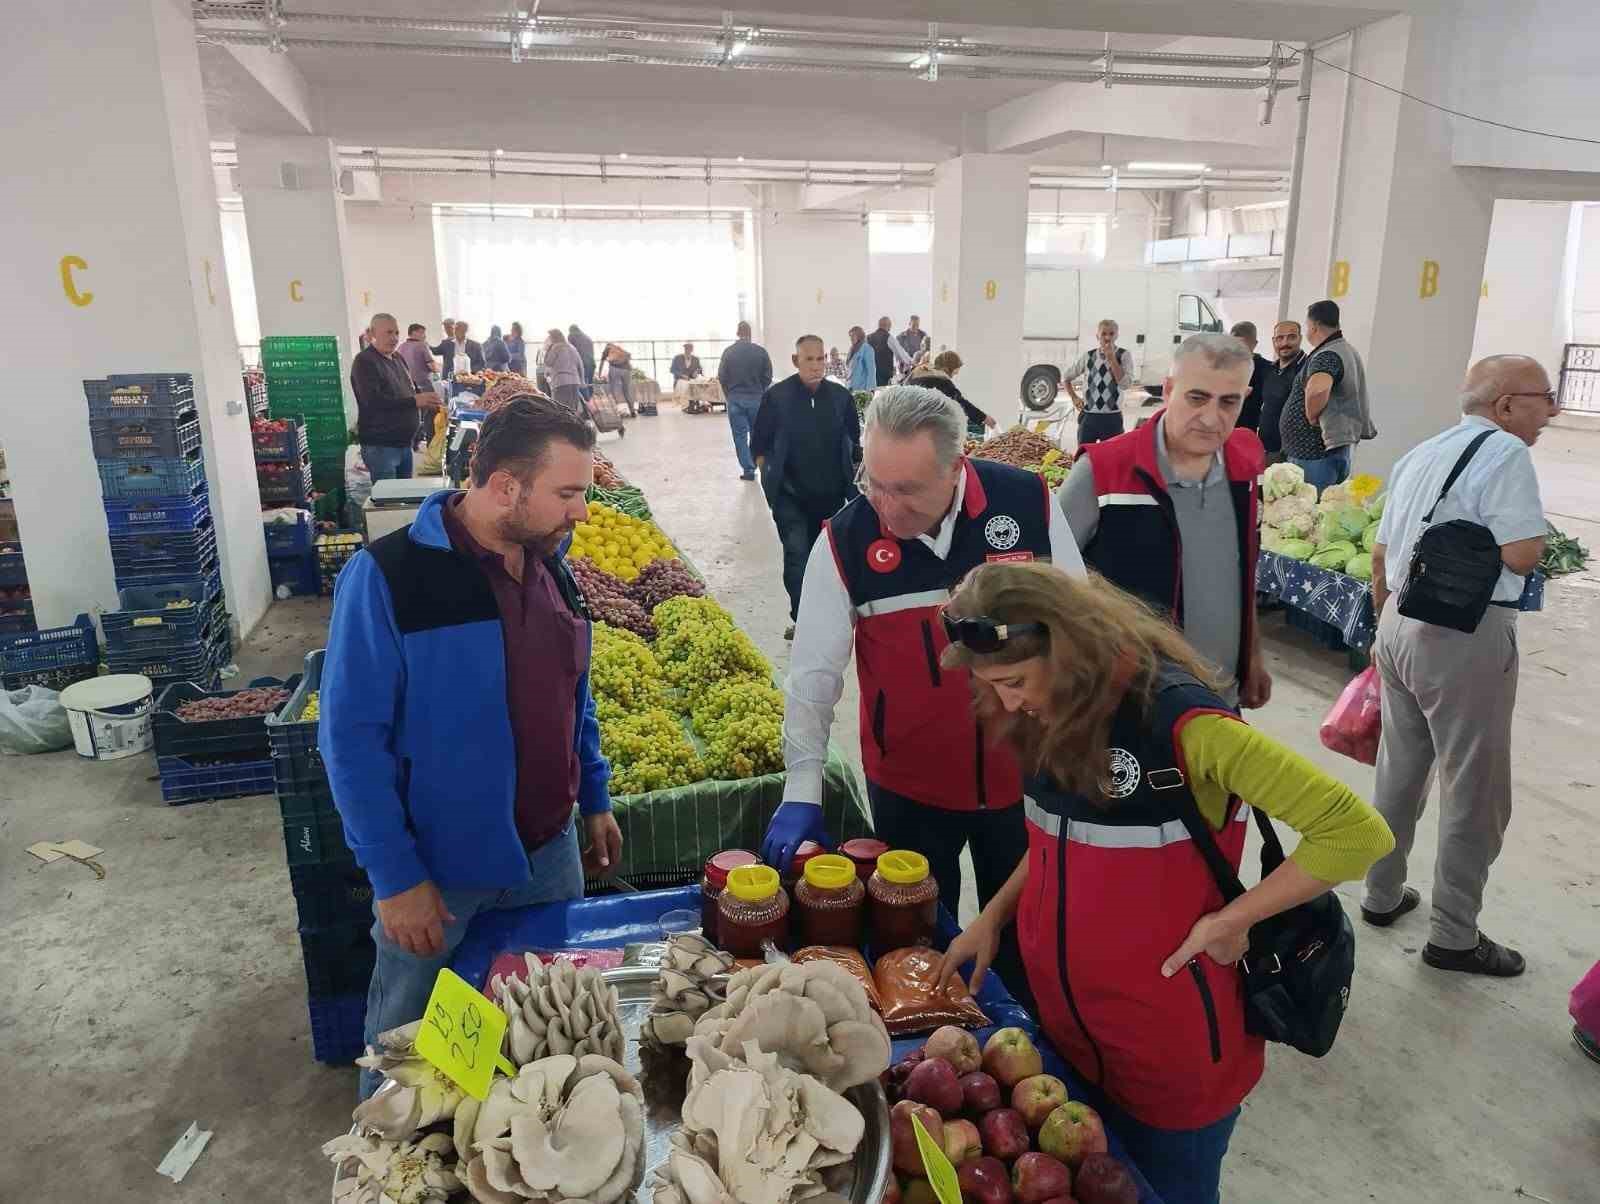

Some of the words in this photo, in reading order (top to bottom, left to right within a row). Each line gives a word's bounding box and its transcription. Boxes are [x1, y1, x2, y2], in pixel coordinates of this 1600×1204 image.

[58, 255, 93, 308] C
[289, 279, 303, 303] C
[1331, 260, 1350, 298] B
[1419, 259, 1440, 299] B
[451, 1002, 482, 1070] 250
